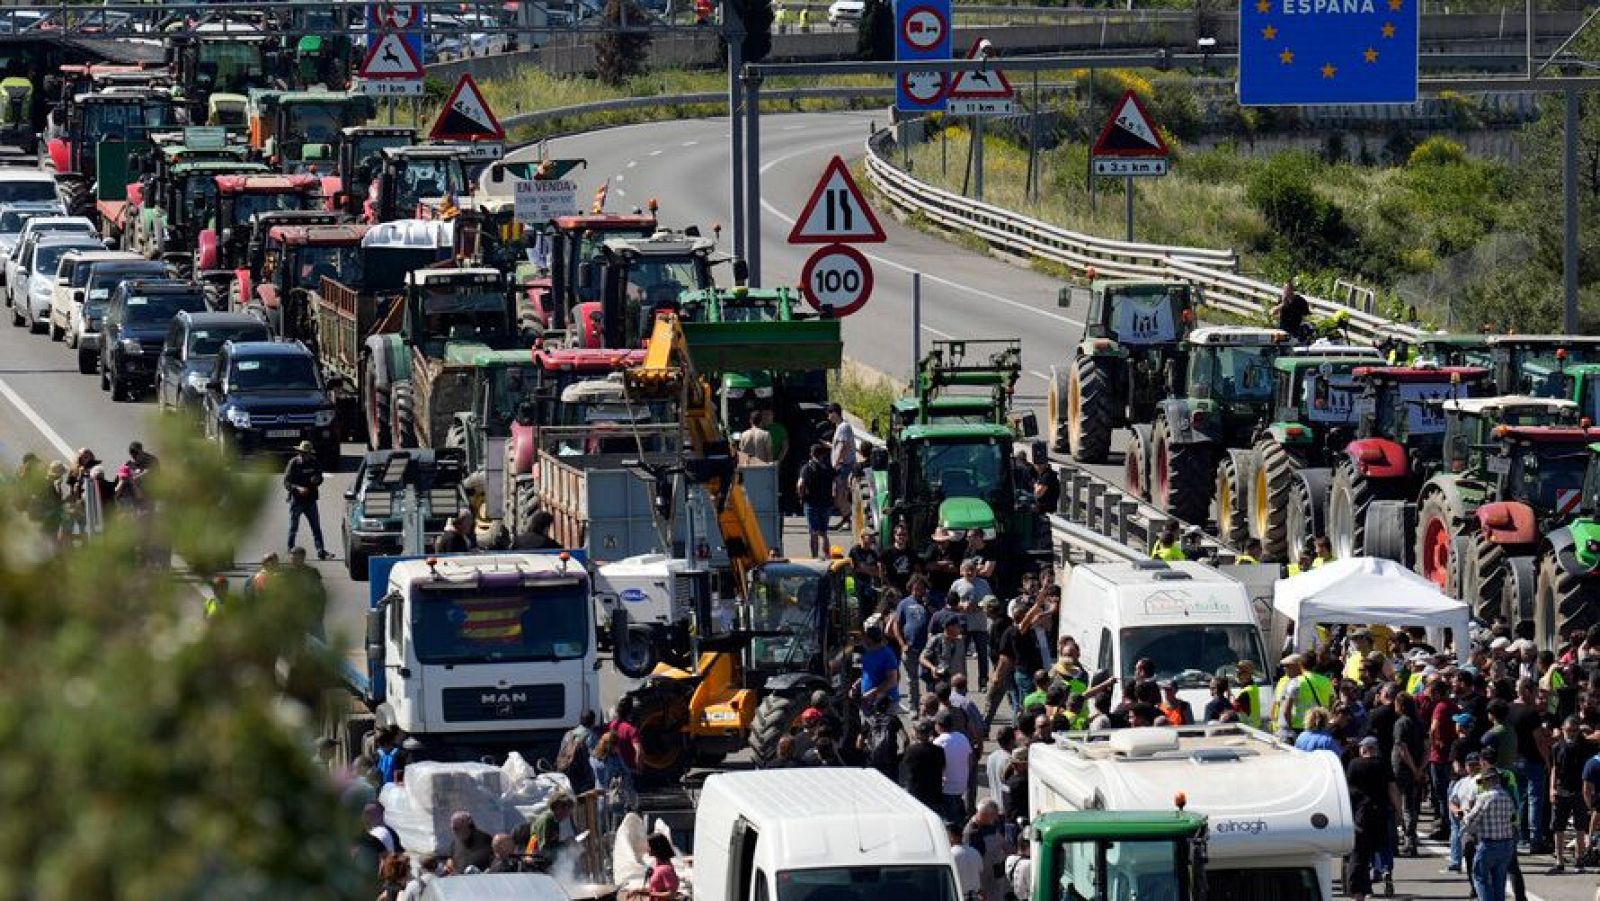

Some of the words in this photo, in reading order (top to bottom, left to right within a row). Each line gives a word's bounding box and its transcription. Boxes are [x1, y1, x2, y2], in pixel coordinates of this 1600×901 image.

[390, 83, 406, 92] km
[966, 103, 975, 112] 11
[979, 103, 995, 112] km
[1132, 163, 1150, 172] km
[517, 182, 531, 193] EN
[535, 181, 571, 192] VENDA
[815, 269, 860, 293] 100
[481, 692, 527, 704] MAN
